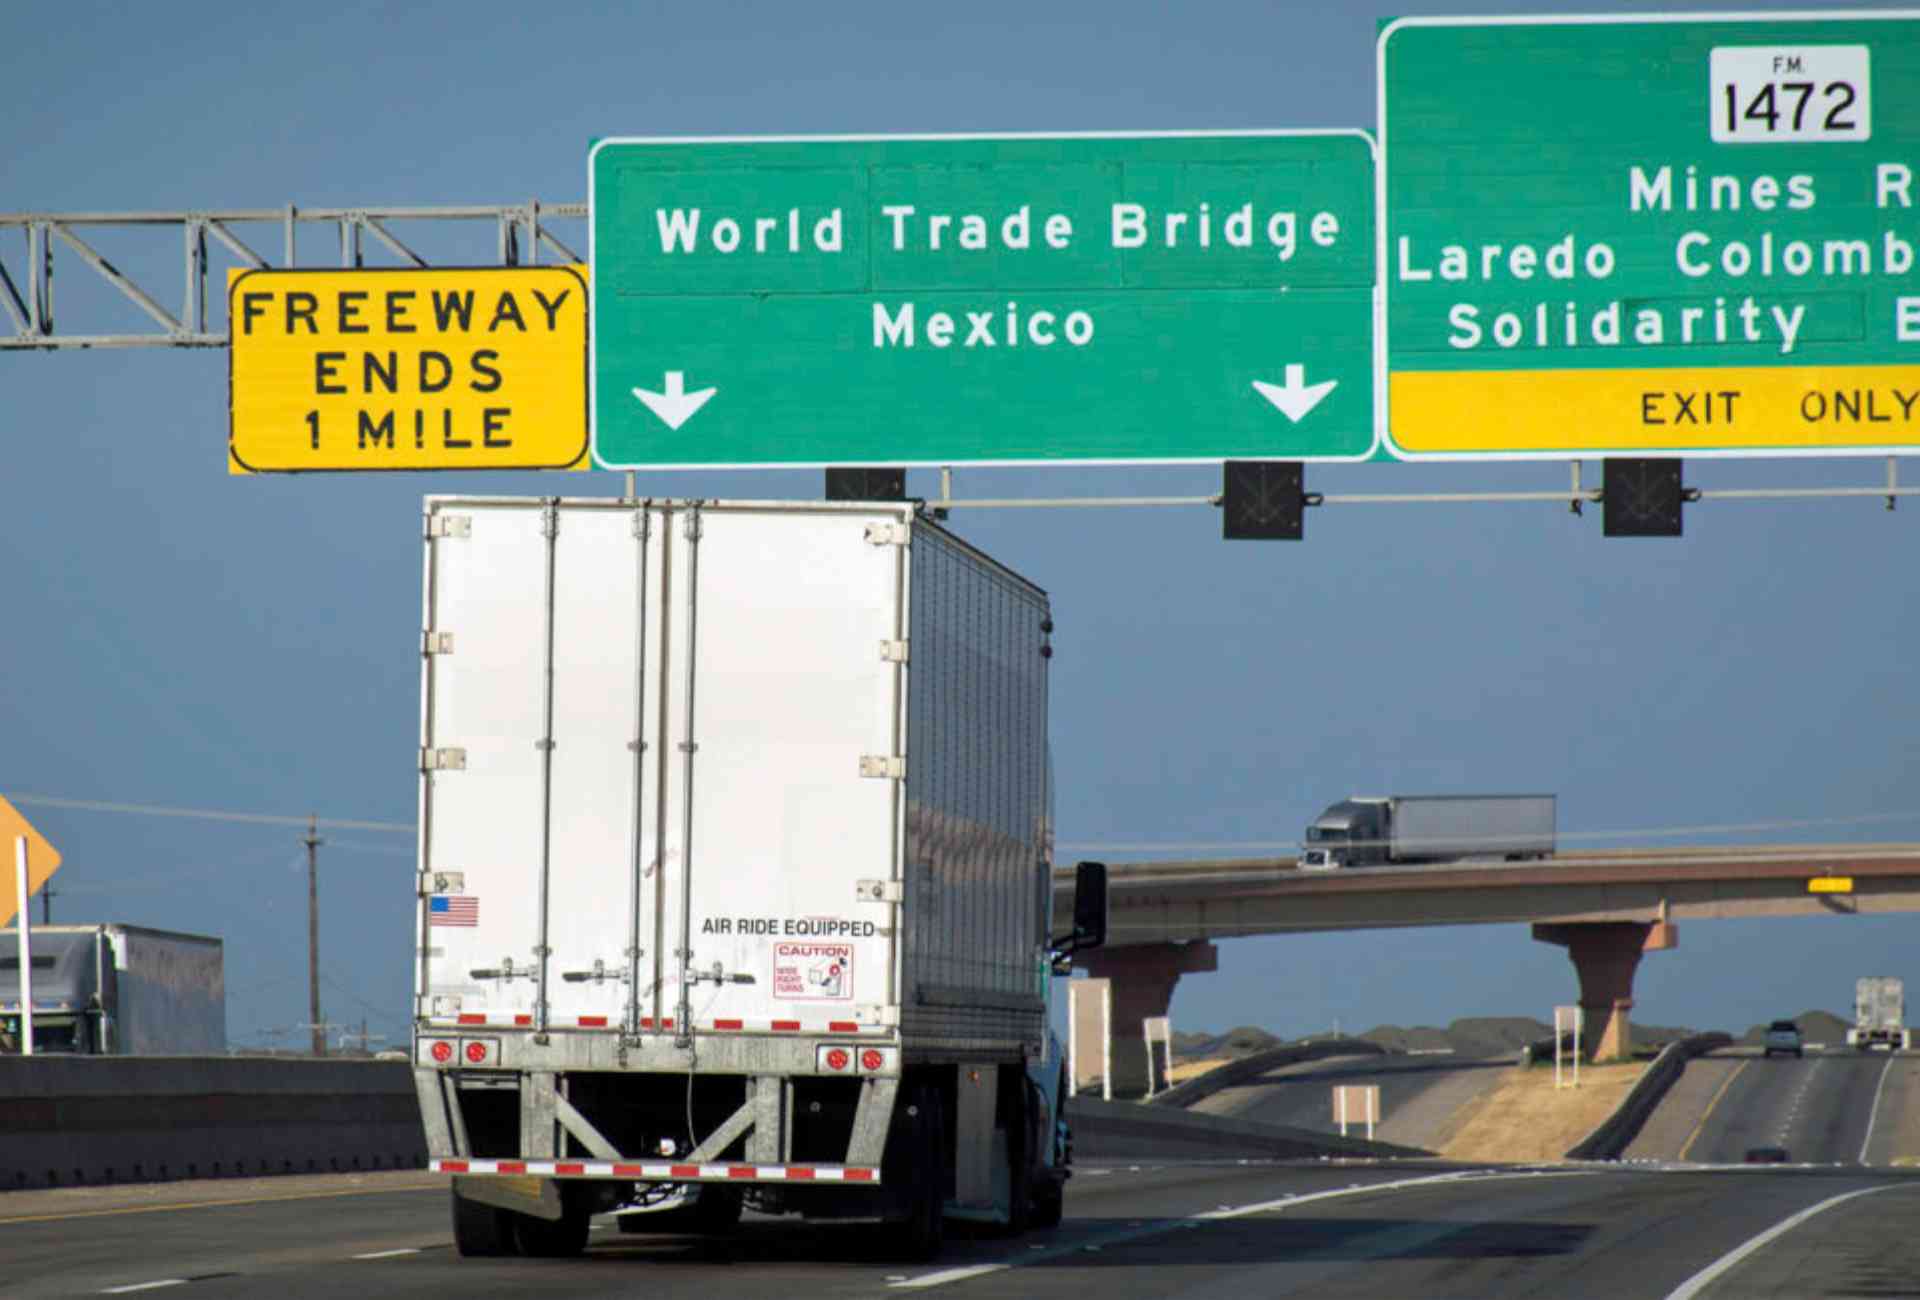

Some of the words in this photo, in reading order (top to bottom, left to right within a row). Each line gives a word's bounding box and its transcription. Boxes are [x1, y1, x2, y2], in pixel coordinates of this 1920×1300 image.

[1726, 81, 1856, 132] 1472
[1630, 166, 1815, 211] Mines
[656, 208, 842, 253] World
[882, 205, 1073, 250] Trade
[1112, 203, 1339, 261] Bridge
[1399, 235, 1615, 281] Laredo
[243, 289, 571, 335] FREEWAY
[873, 301, 1094, 347] Mexico
[1449, 298, 1804, 353] Solidarity
[315, 350, 503, 395] ENDS
[306, 410, 320, 449] 1
[357, 408, 513, 449] MILE
[1642, 391, 1740, 424] EXIT
[1801, 390, 1920, 422] ONLY
[702, 918, 731, 934] AIR
[738, 919, 778, 935] RIDE
[784, 919, 874, 936] EQUIPPED
[779, 946, 849, 957] CAUTION
